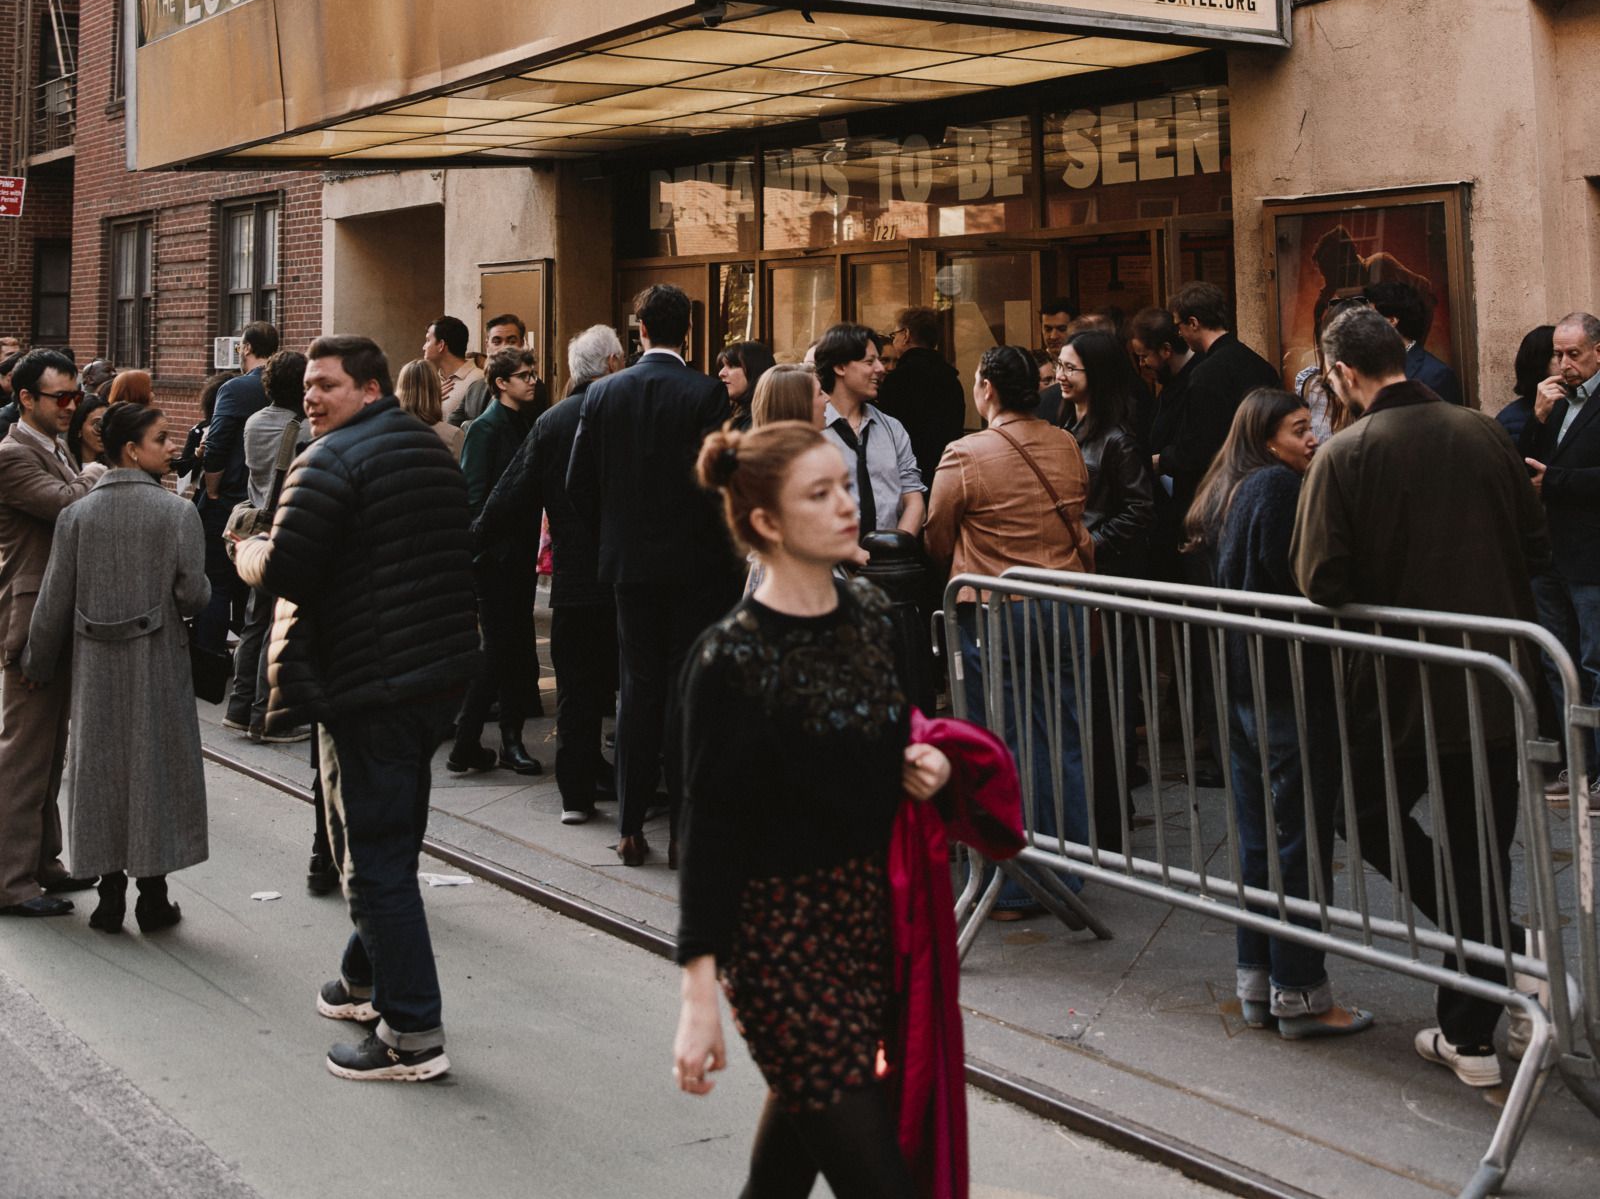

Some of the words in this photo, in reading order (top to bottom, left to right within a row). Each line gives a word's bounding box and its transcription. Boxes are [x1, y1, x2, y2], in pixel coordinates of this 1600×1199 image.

[863, 134, 933, 209] TO
[957, 115, 1024, 201] BE
[873, 223, 898, 241] 121
